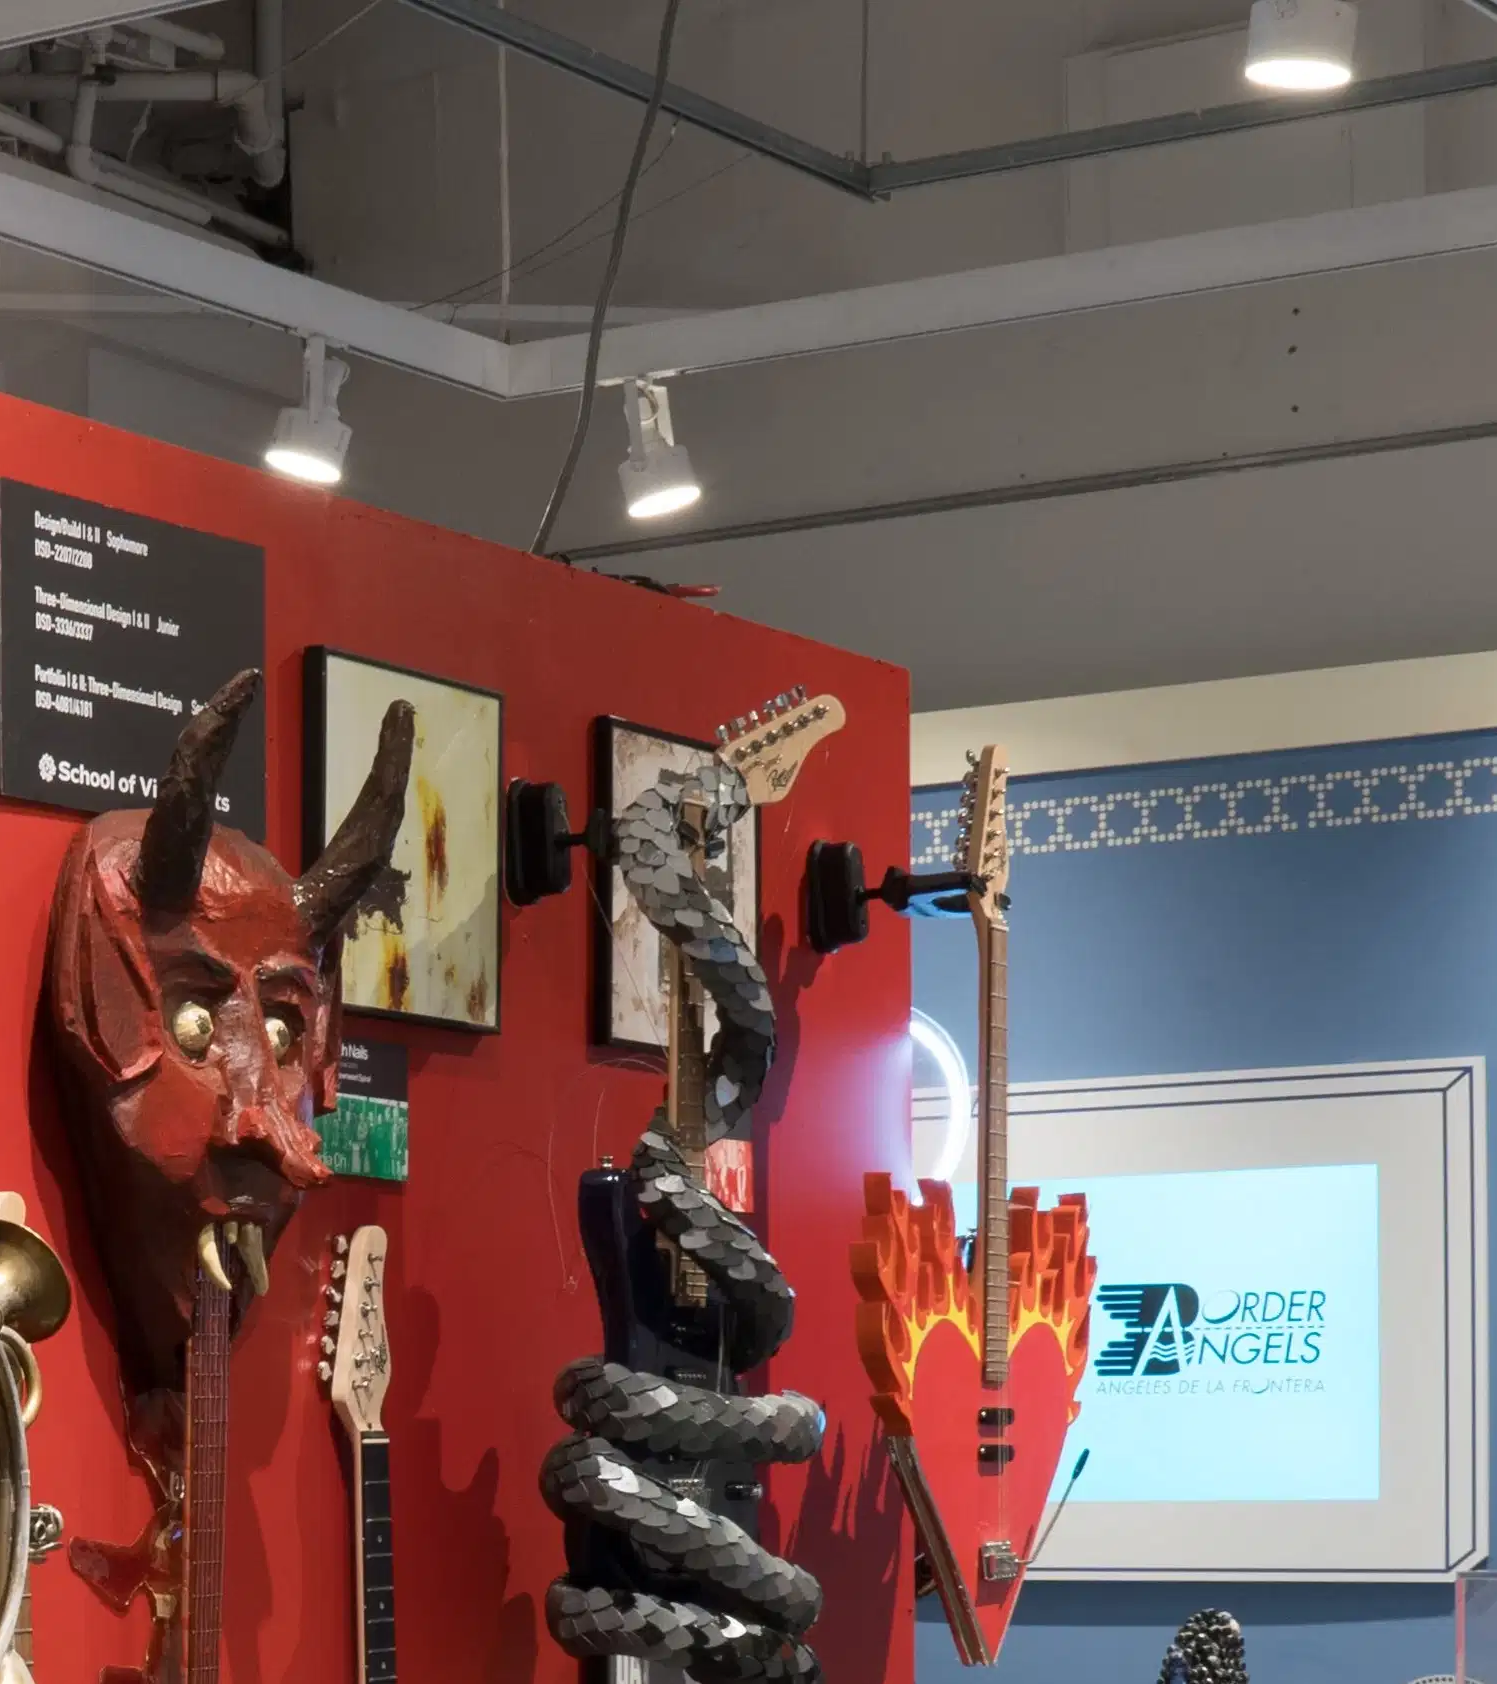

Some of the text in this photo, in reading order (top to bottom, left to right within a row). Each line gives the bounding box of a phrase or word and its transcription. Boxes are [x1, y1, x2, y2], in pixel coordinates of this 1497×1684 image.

[34, 510, 81, 537] Design/Build
[87, 525, 94, 542] &
[106, 530, 149, 557] Sophomore
[34, 585, 105, 621] Three-Dimensional
[105, 603, 132, 630] Design
[136, 611, 143, 629] &
[156, 615, 180, 637] Junior
[34, 664, 66, 688] Portfolio
[71, 673, 78, 690] &
[87, 675, 157, 708] Three-Dimensional
[157, 690, 183, 716] Design
[58, 759, 115, 791] School
[118, 773, 136, 795] of
[1096, 1379, 1172, 1396] ANGELES
[1178, 1379, 1201, 1395] DE
[1206, 1379, 1226, 1395] LA
